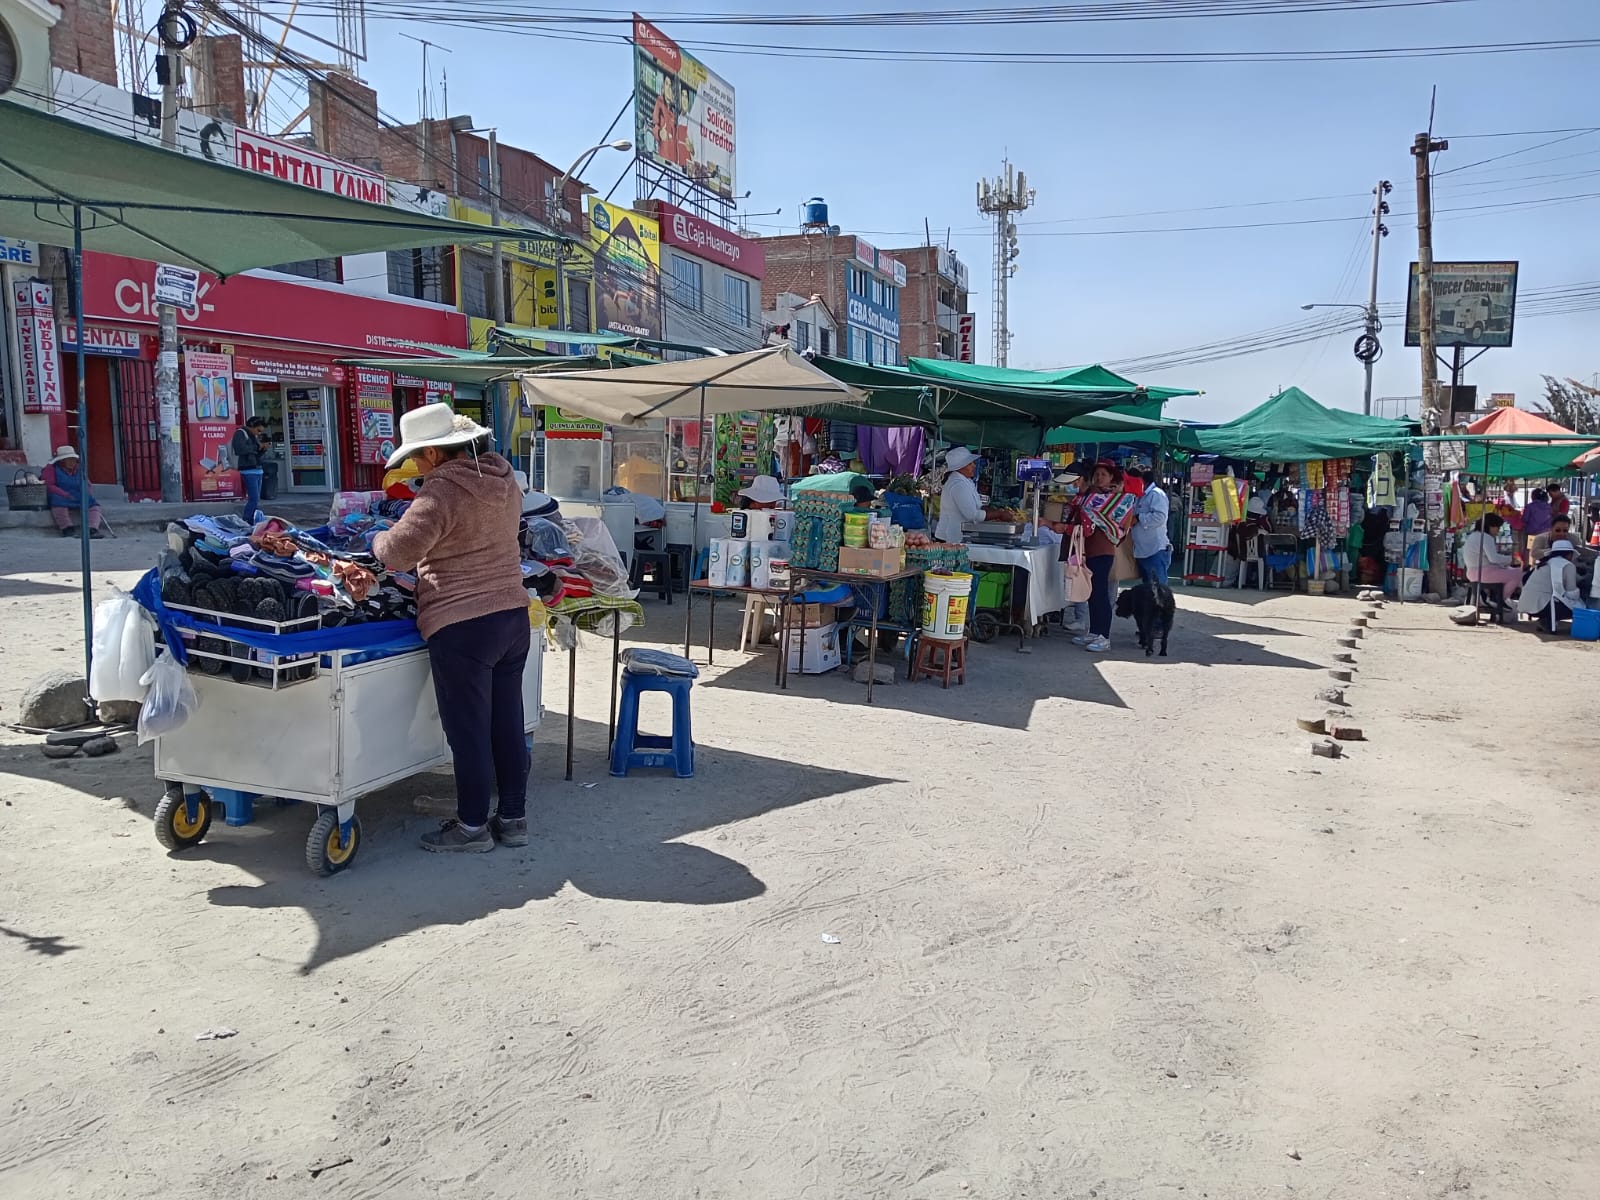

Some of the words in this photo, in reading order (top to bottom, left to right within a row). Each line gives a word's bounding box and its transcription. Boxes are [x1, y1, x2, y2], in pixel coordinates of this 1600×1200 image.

[706, 106, 733, 136] Solicita
[700, 123, 708, 138] tu
[708, 129, 734, 154] crédito
[688, 222, 705, 248] Caja
[705, 229, 740, 262] Huancayo
[540, 304, 558, 315] bite
[849, 298, 868, 324] CEBA
[66, 326, 135, 348] DENTAL
[21, 318, 38, 402] INYECTABLE
[38, 319, 59, 403] MEDICINA
[250, 359, 284, 369] Cámbiate
[272, 368, 295, 376] rápida
[357, 373, 390, 385] TECNICO
